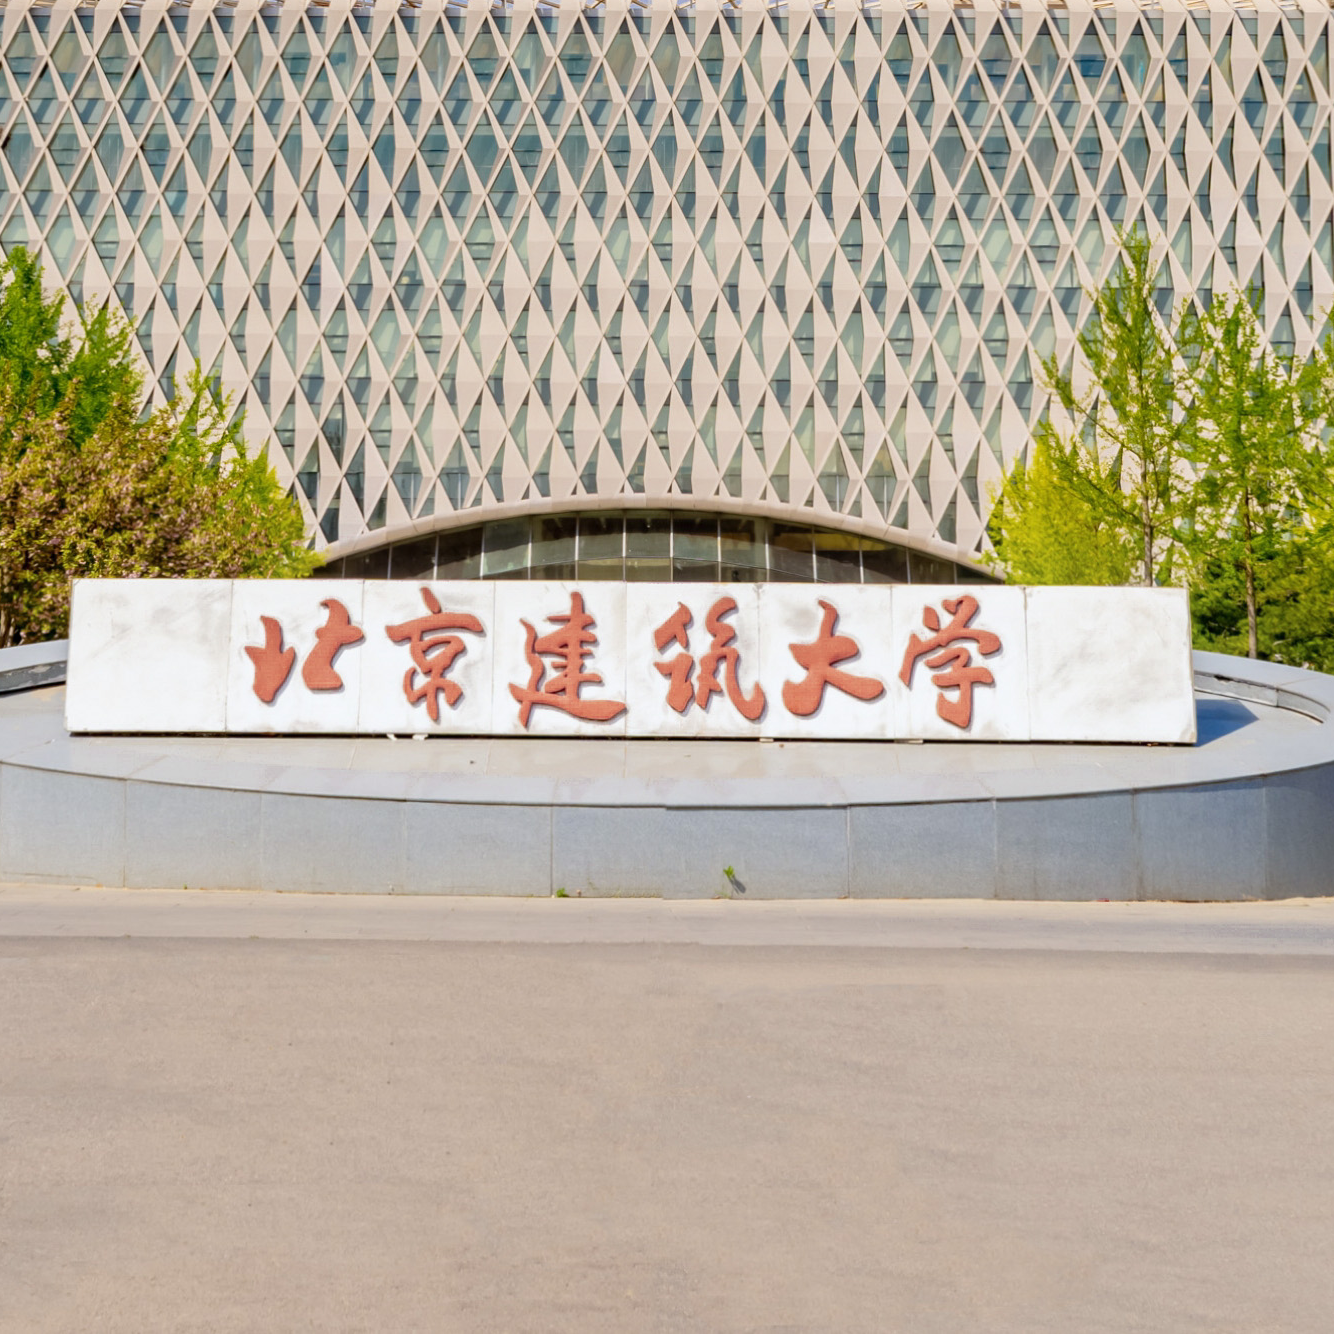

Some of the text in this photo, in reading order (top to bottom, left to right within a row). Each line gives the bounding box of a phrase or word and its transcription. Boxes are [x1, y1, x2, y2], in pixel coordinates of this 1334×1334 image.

[244, 585, 1004, 729] 北京建筑大学
